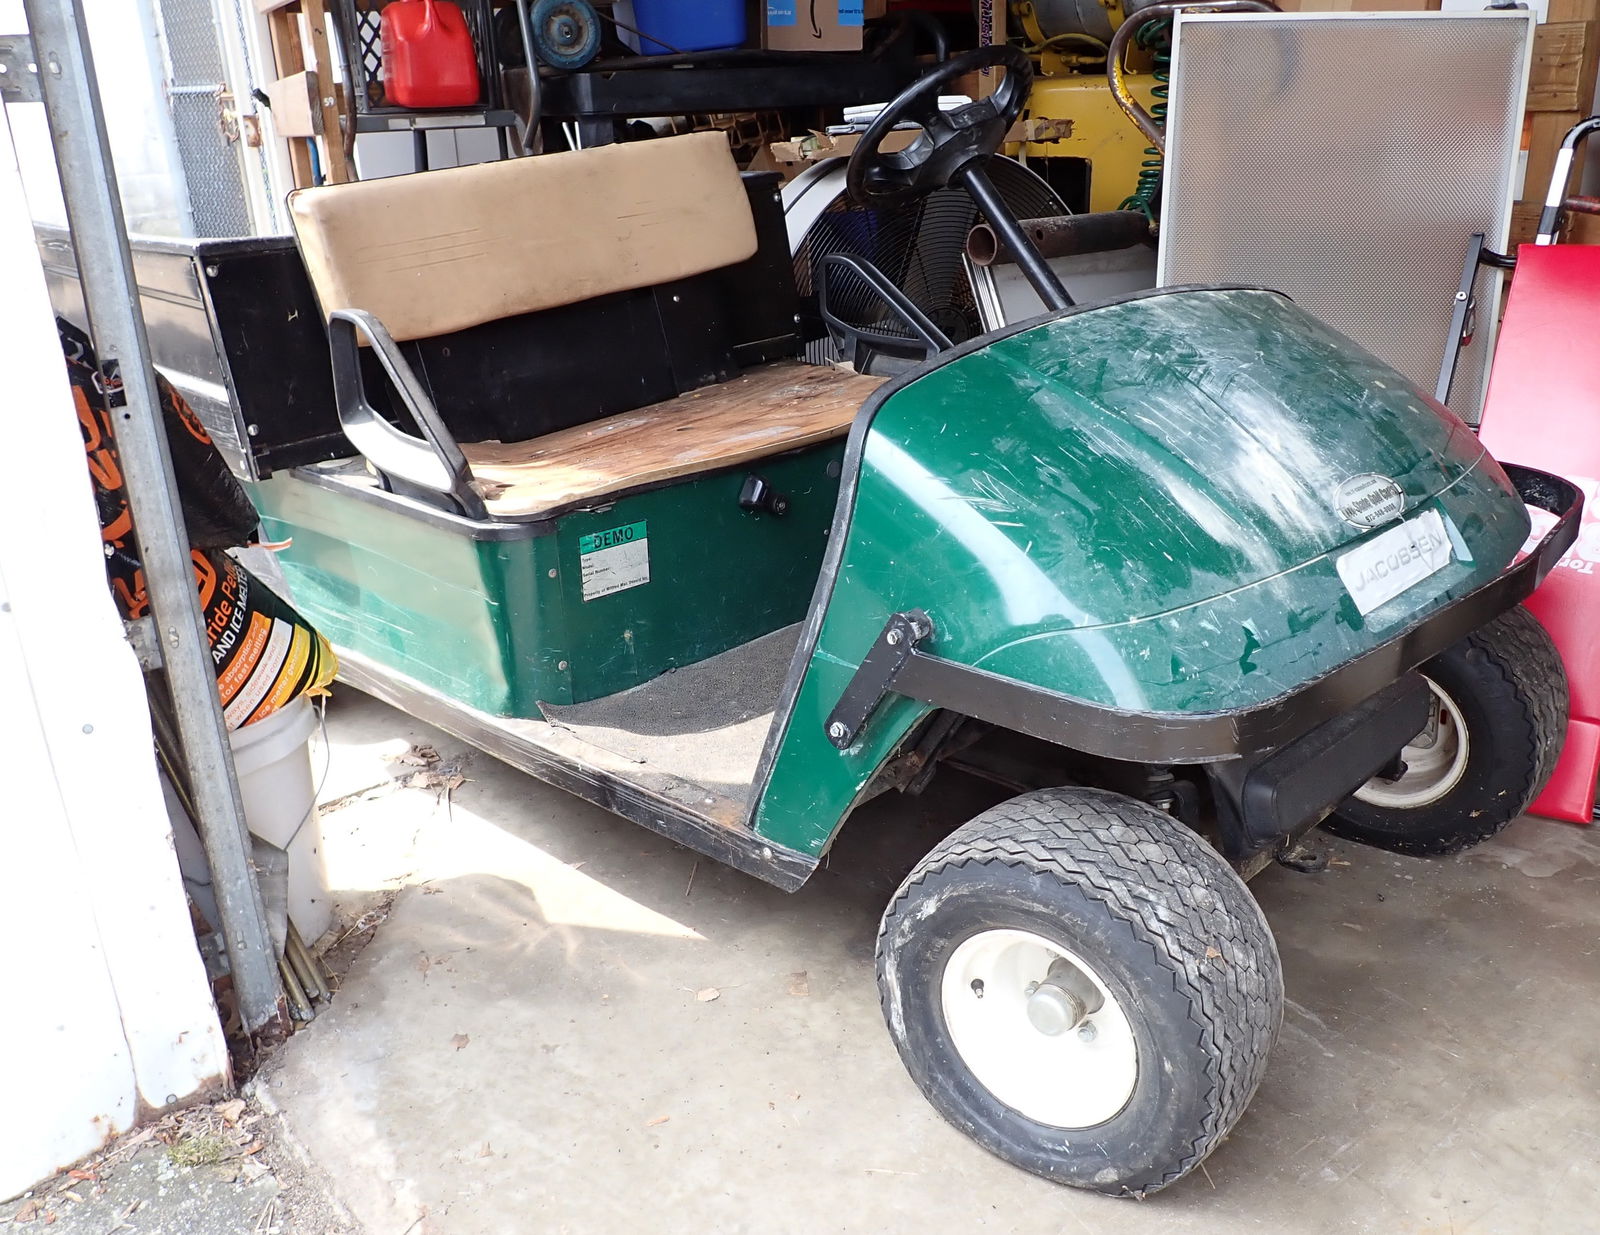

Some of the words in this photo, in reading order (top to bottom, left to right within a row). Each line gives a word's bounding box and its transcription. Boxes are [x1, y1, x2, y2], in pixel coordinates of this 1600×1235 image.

[593, 526, 635, 549] DEMO
[1355, 529, 1443, 592] JACOBSEN
[234, 564, 248, 612] MELTER
[229, 607, 245, 634] ICE
[211, 630, 235, 665] AND
[222, 685, 235, 699] for
[233, 663, 249, 685] fast
[248, 627, 267, 663] melting
[225, 638, 253, 684] absorption
[235, 698, 255, 721] when
[254, 675, 271, 698] used
[246, 663, 268, 697] sidewalk
[270, 676, 289, 704] melter
